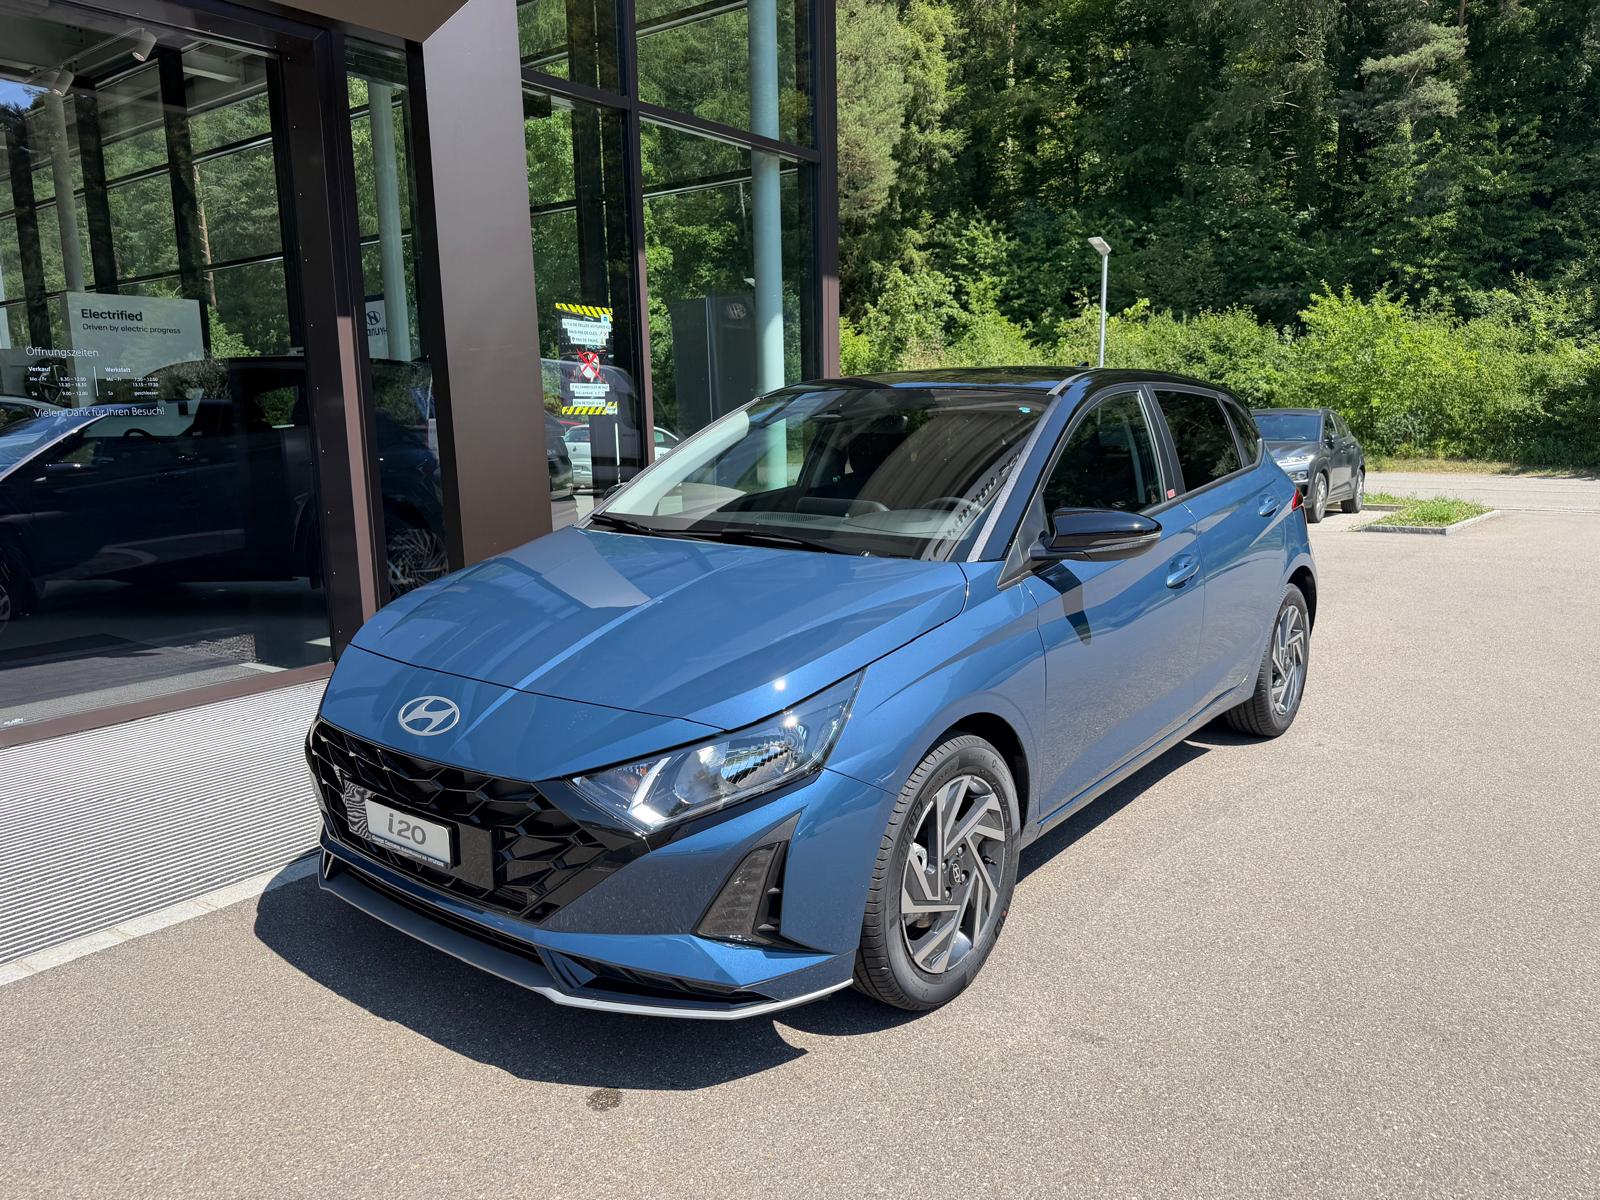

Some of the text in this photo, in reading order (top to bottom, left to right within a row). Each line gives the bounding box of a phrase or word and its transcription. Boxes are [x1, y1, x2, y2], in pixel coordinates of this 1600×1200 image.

[81, 308, 143, 322] Electrified
[82, 323, 181, 336] Driven by electric progress
[25, 346, 99, 358] Öffnungszeiten
[33, 406, 165, 418] Vielen Dank für Ihren Besuch!
[388, 812, 426, 845] i20
